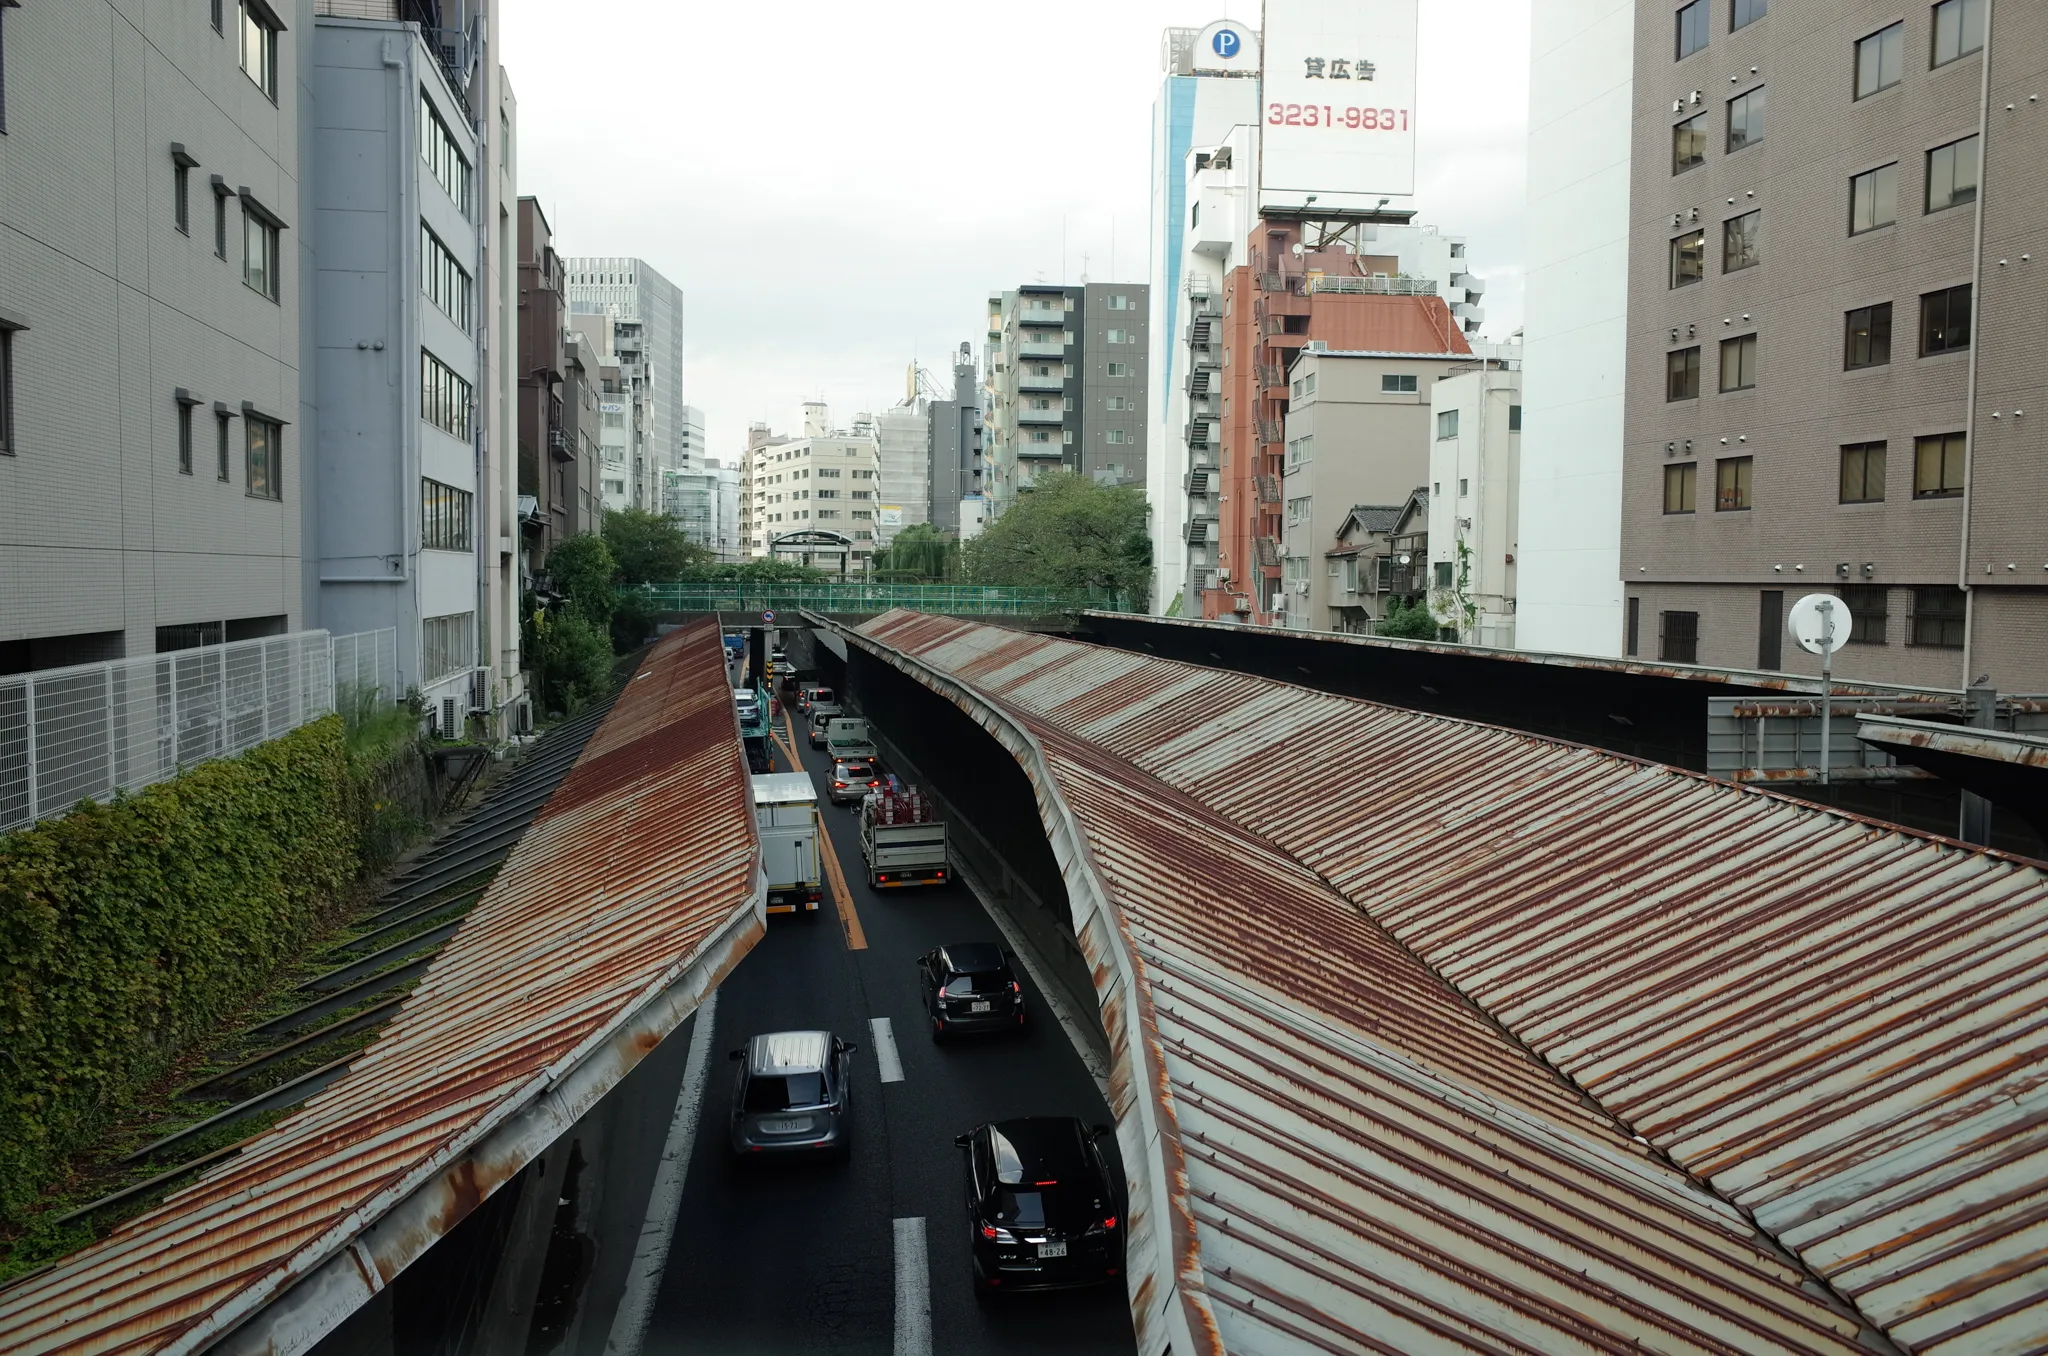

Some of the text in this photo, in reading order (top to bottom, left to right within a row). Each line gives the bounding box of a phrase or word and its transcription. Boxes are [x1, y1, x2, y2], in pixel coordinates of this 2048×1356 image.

[1219, 33, 1235, 54] P
[1304, 57, 1375, 81] 貸広告
[1268, 103, 1408, 131] 3231-9831
